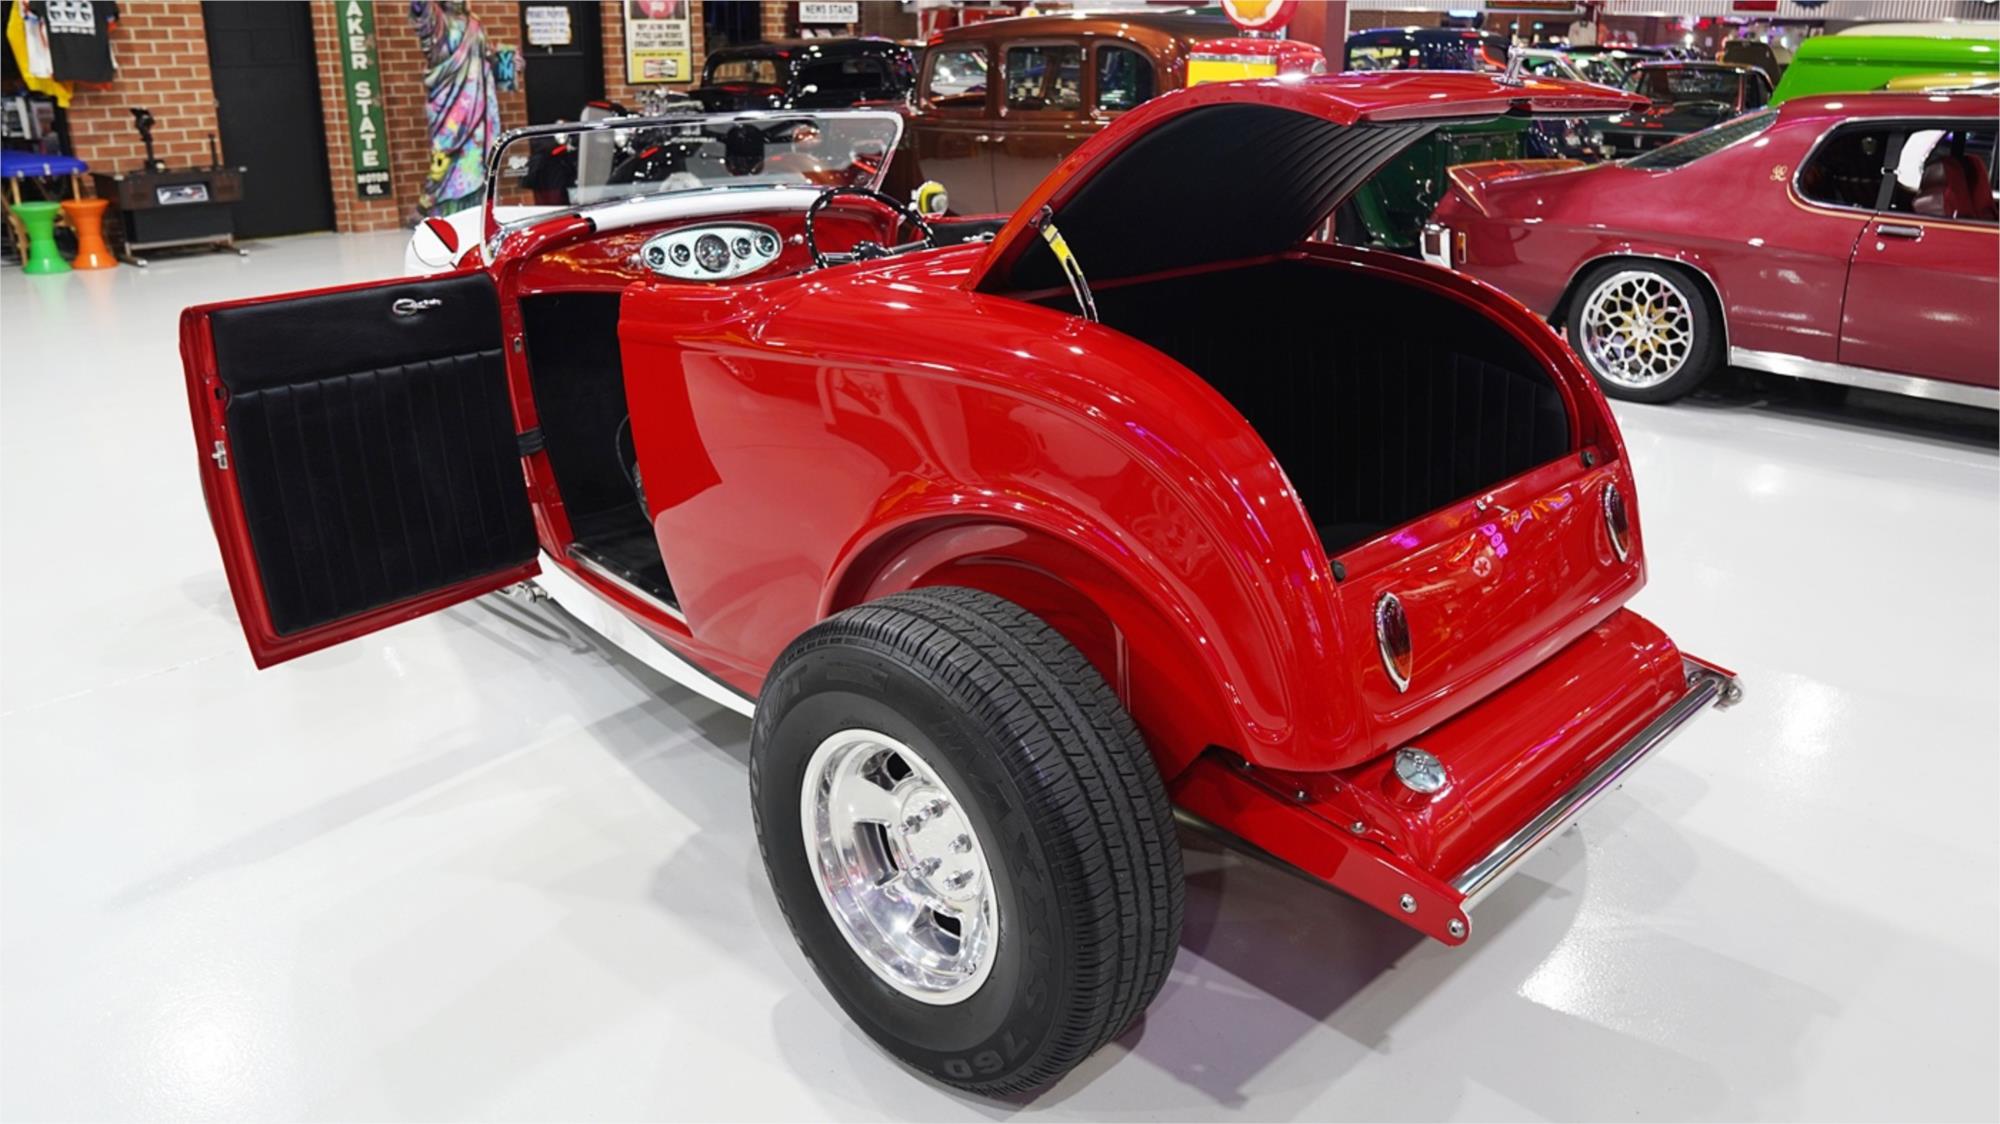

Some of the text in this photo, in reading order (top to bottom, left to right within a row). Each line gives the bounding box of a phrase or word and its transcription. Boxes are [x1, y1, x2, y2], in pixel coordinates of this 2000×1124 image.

[805, 4, 854, 15] NEWS STAND
[354, 81, 379, 167] STATE
[357, 172, 389, 184] MOTOR
[366, 184, 384, 195] OIL
[943, 1029, 1031, 1080] 760
